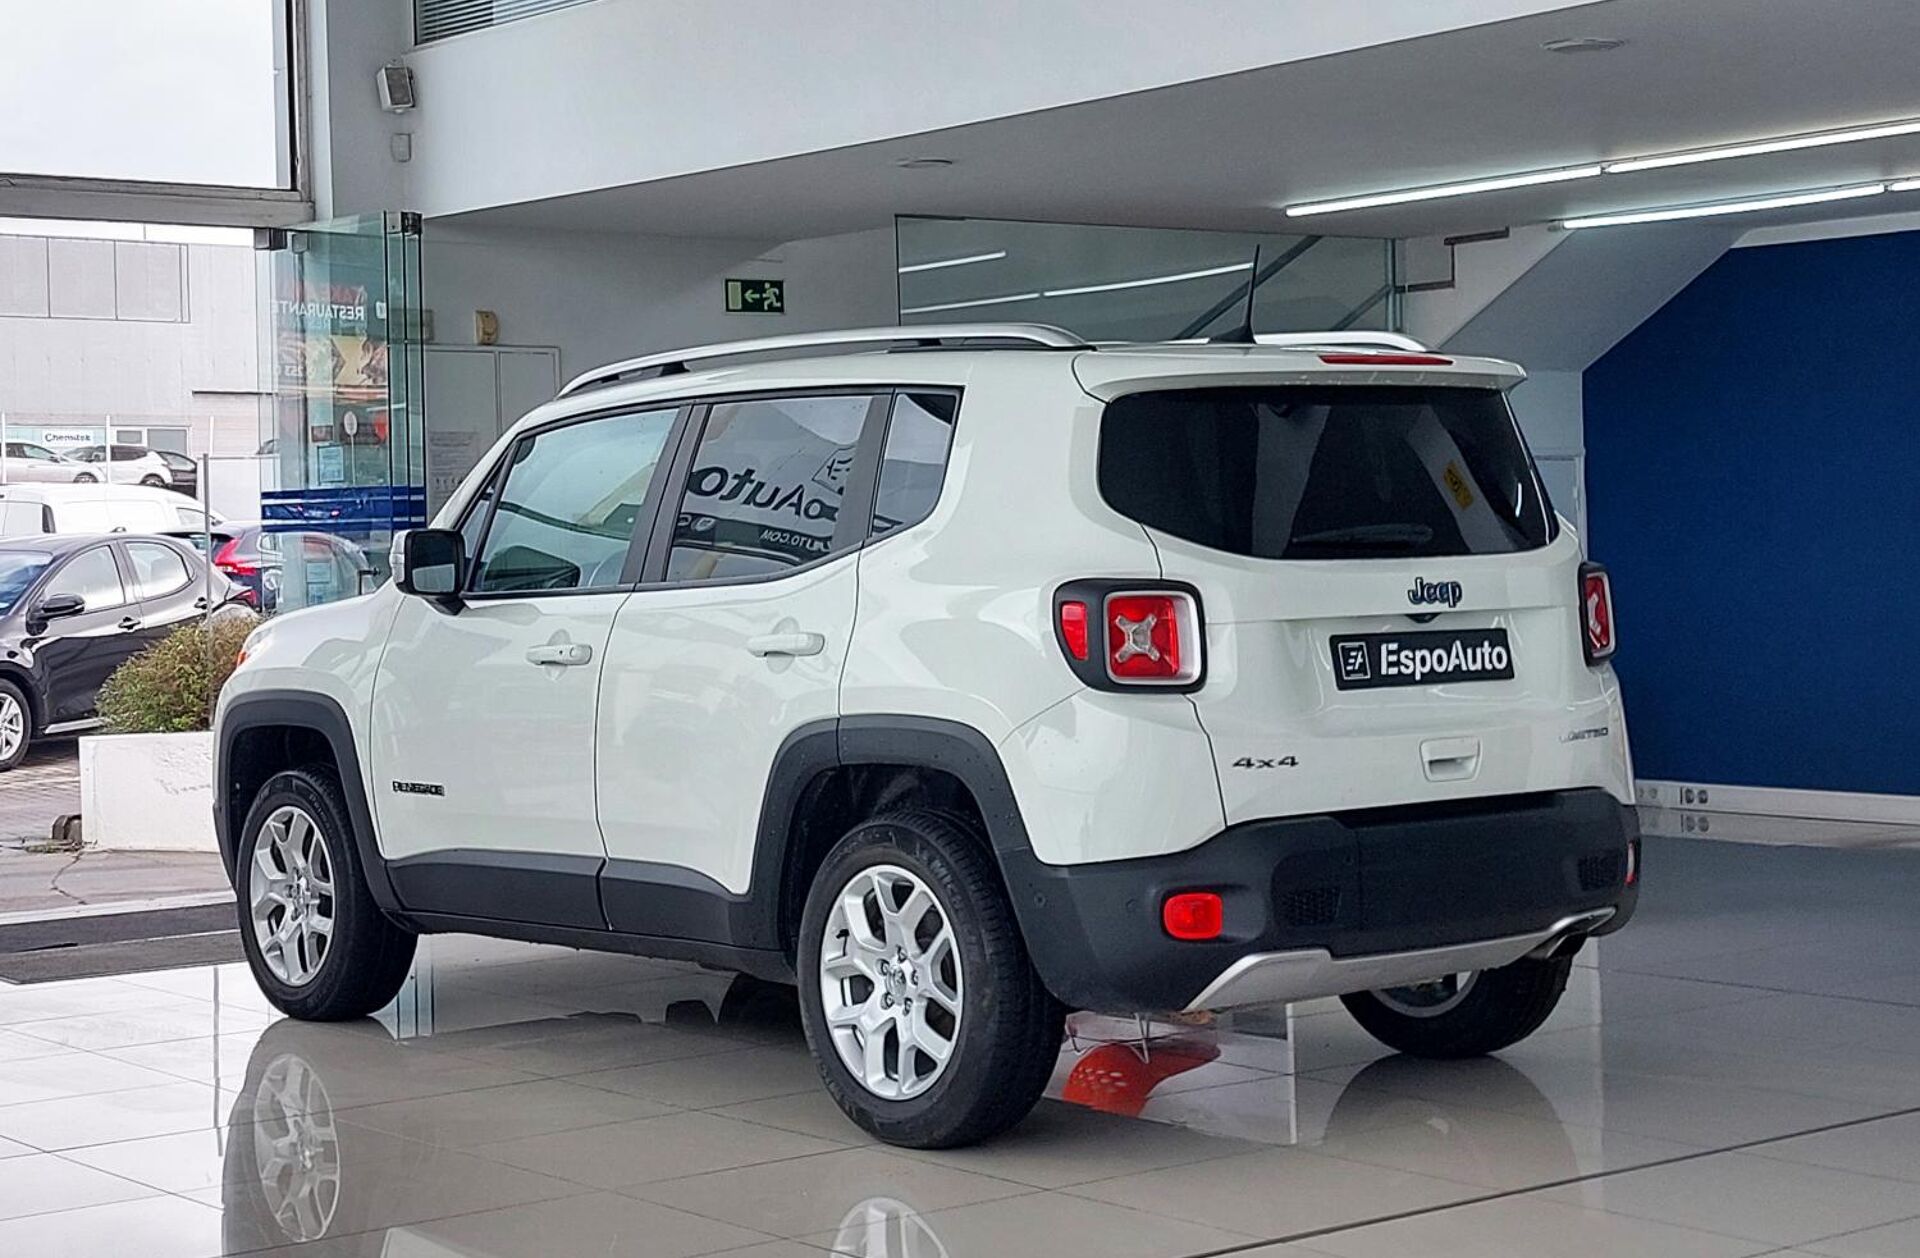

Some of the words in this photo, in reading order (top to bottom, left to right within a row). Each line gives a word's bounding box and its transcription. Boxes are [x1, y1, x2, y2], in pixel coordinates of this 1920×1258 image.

[1407, 576, 1463, 608] Jeep
[1380, 640, 1508, 681] EspoAuto
[1232, 756, 1299, 768] 4x4
